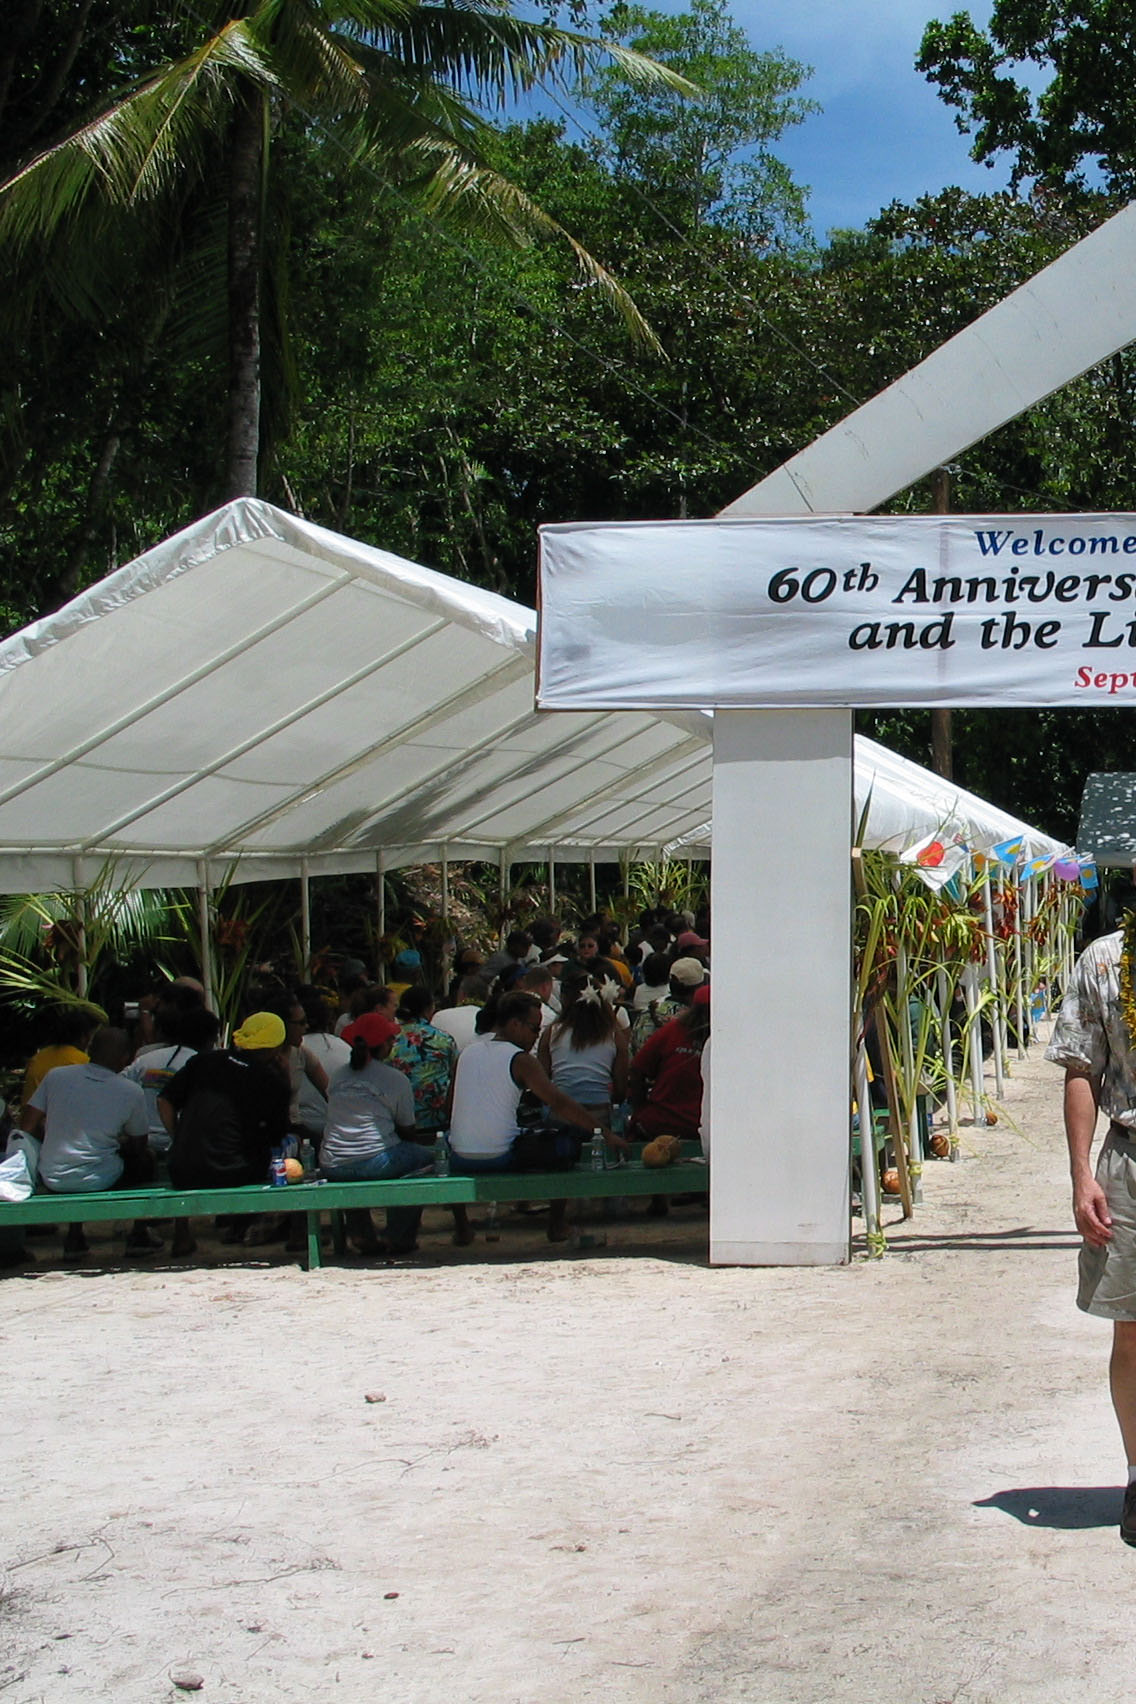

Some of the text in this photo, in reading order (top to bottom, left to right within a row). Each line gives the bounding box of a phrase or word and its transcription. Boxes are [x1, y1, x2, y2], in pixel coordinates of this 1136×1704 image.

[767, 562, 879, 604] 60th
[848, 611, 956, 650] and
[980, 610, 1062, 650] the
